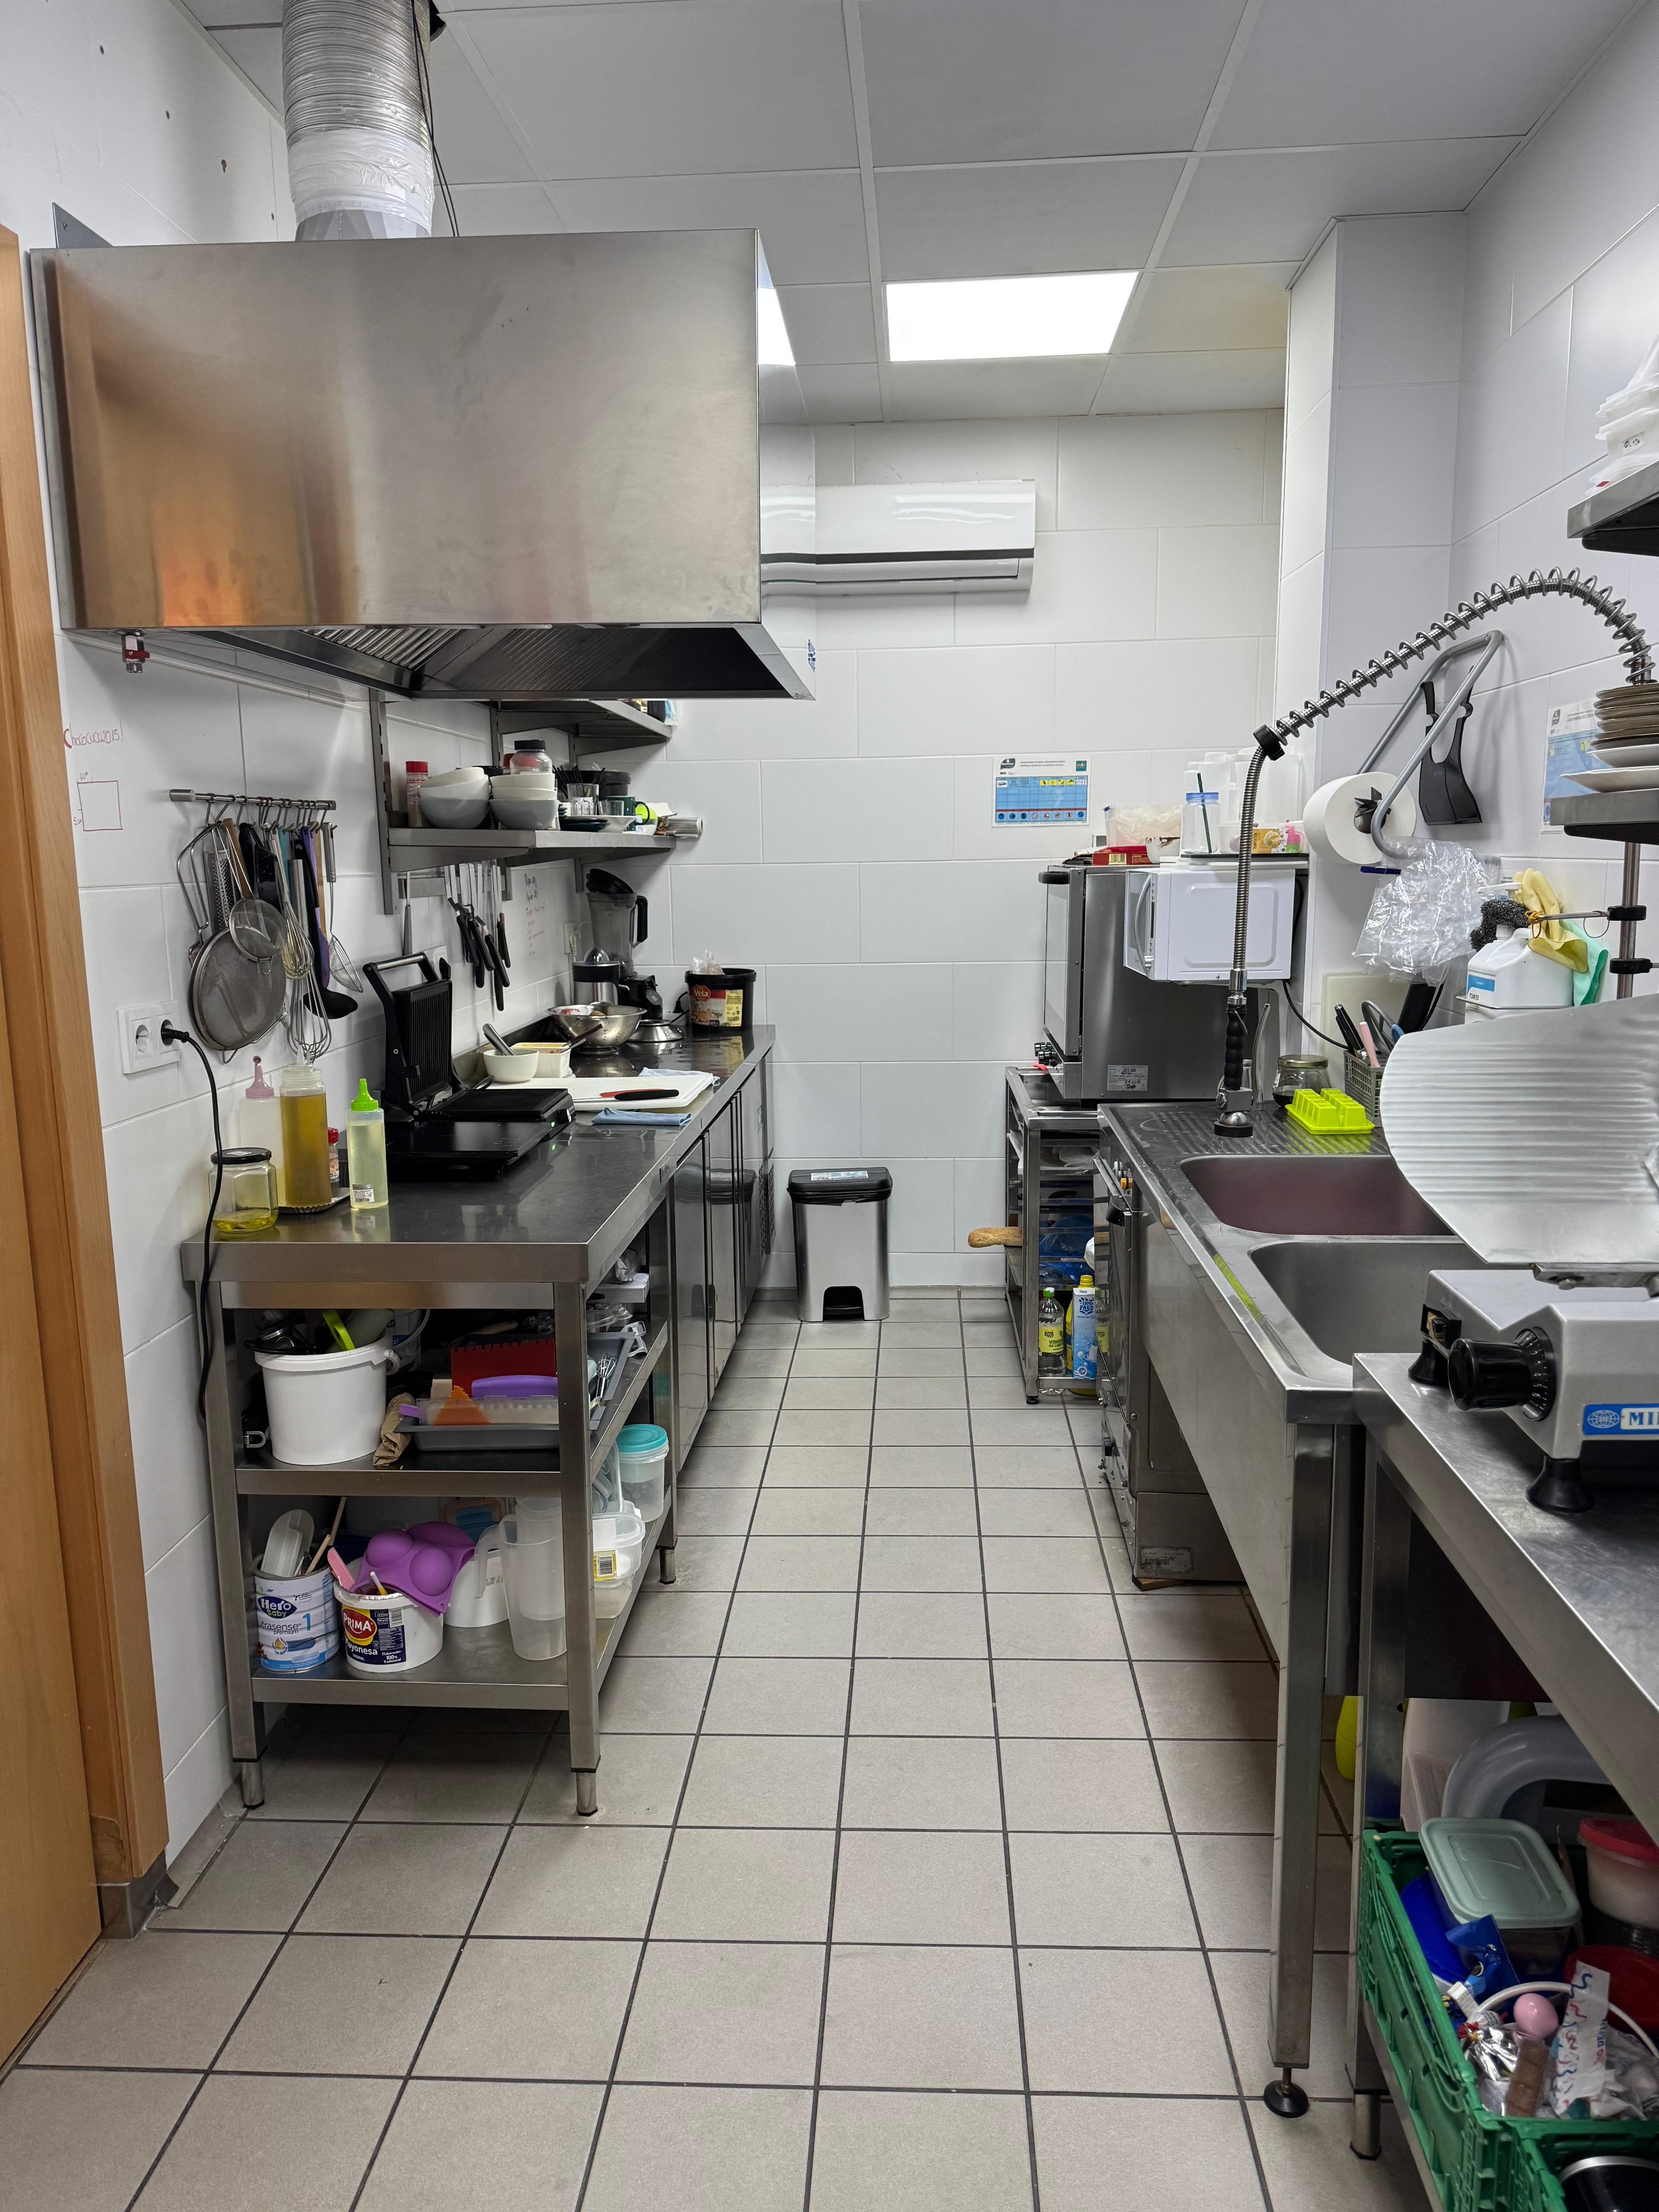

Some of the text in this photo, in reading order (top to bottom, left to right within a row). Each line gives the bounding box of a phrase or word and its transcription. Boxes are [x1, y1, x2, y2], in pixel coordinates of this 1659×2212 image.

[694, 988, 709, 997] Vela
[1629, 1411, 1659, 1426] MI
[261, 1598, 291, 1611] Hero
[302, 1613, 311, 1631] 1
[343, 1612, 372, 1632] PRIMA
[346, 1638, 378, 1656] Mayonesa
